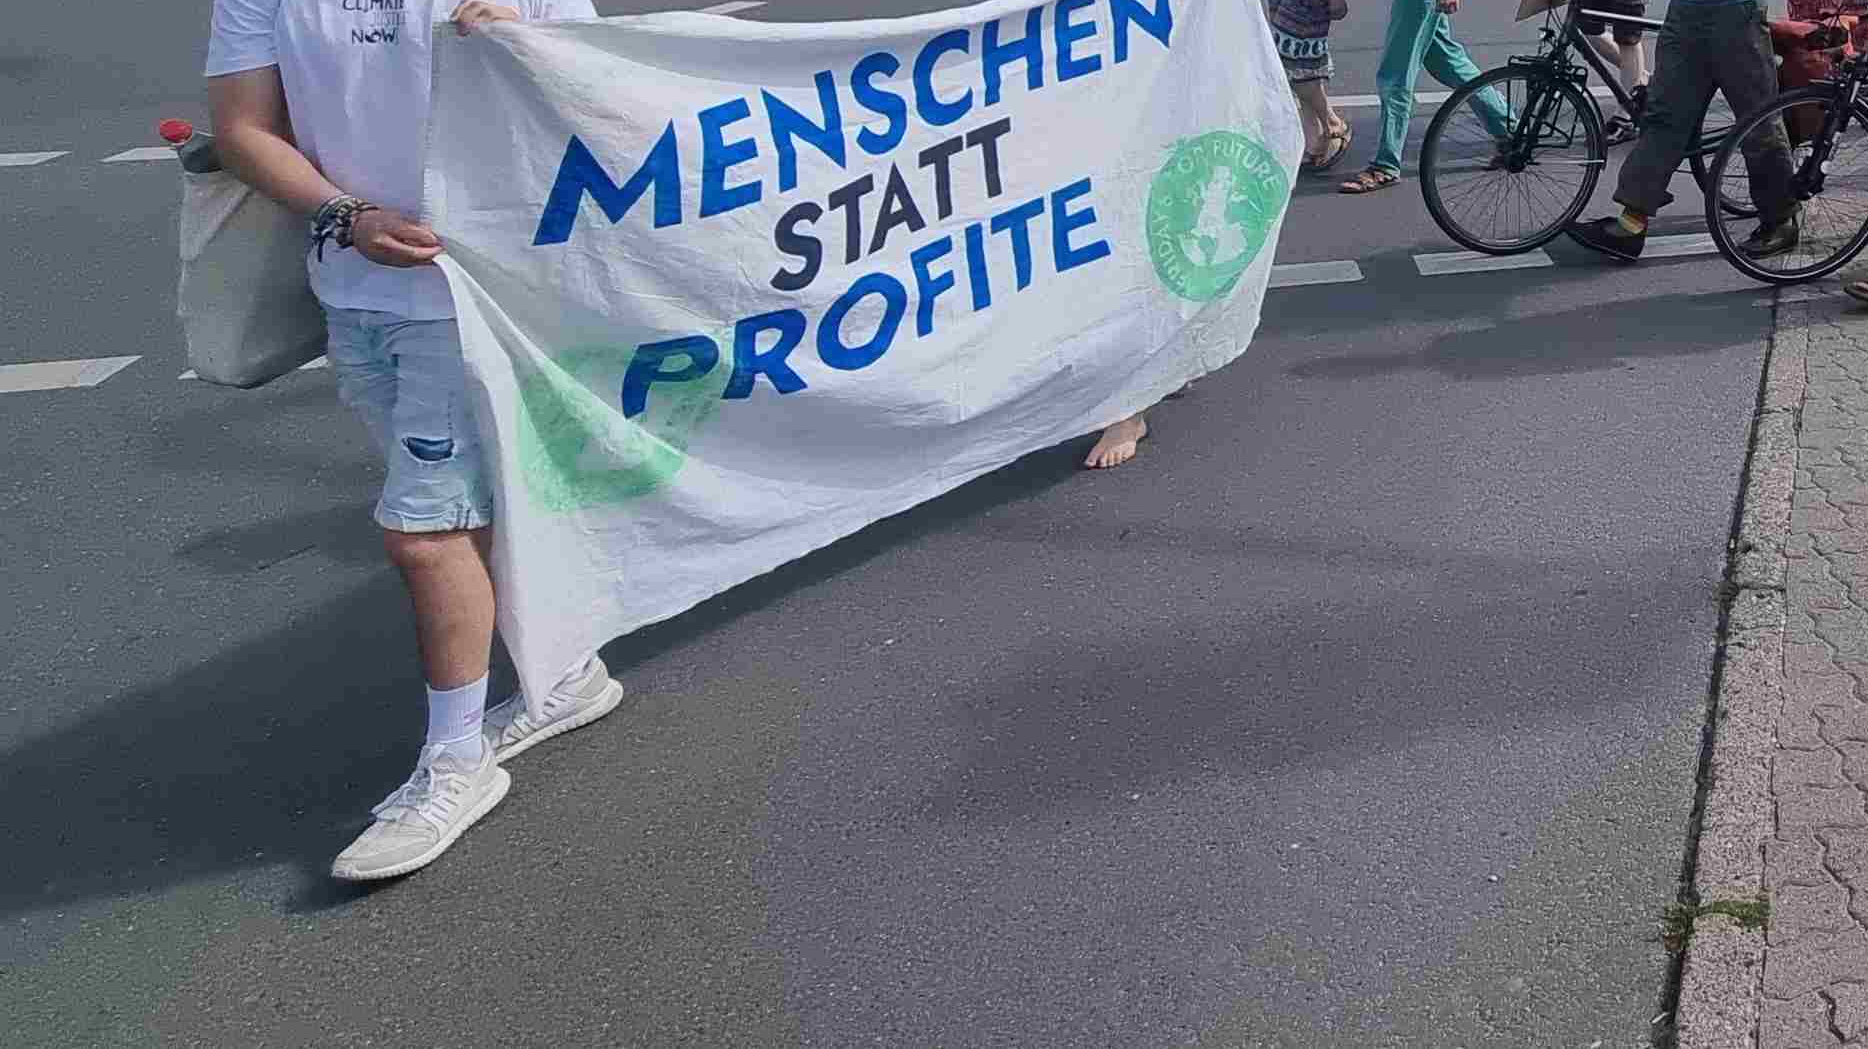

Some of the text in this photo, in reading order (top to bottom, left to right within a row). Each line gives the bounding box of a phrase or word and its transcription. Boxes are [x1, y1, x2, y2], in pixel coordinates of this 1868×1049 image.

[770, 117, 1011, 292] STATT
[1213, 140, 1280, 191] FUTURE
[620, 176, 1111, 420] PROFITE
